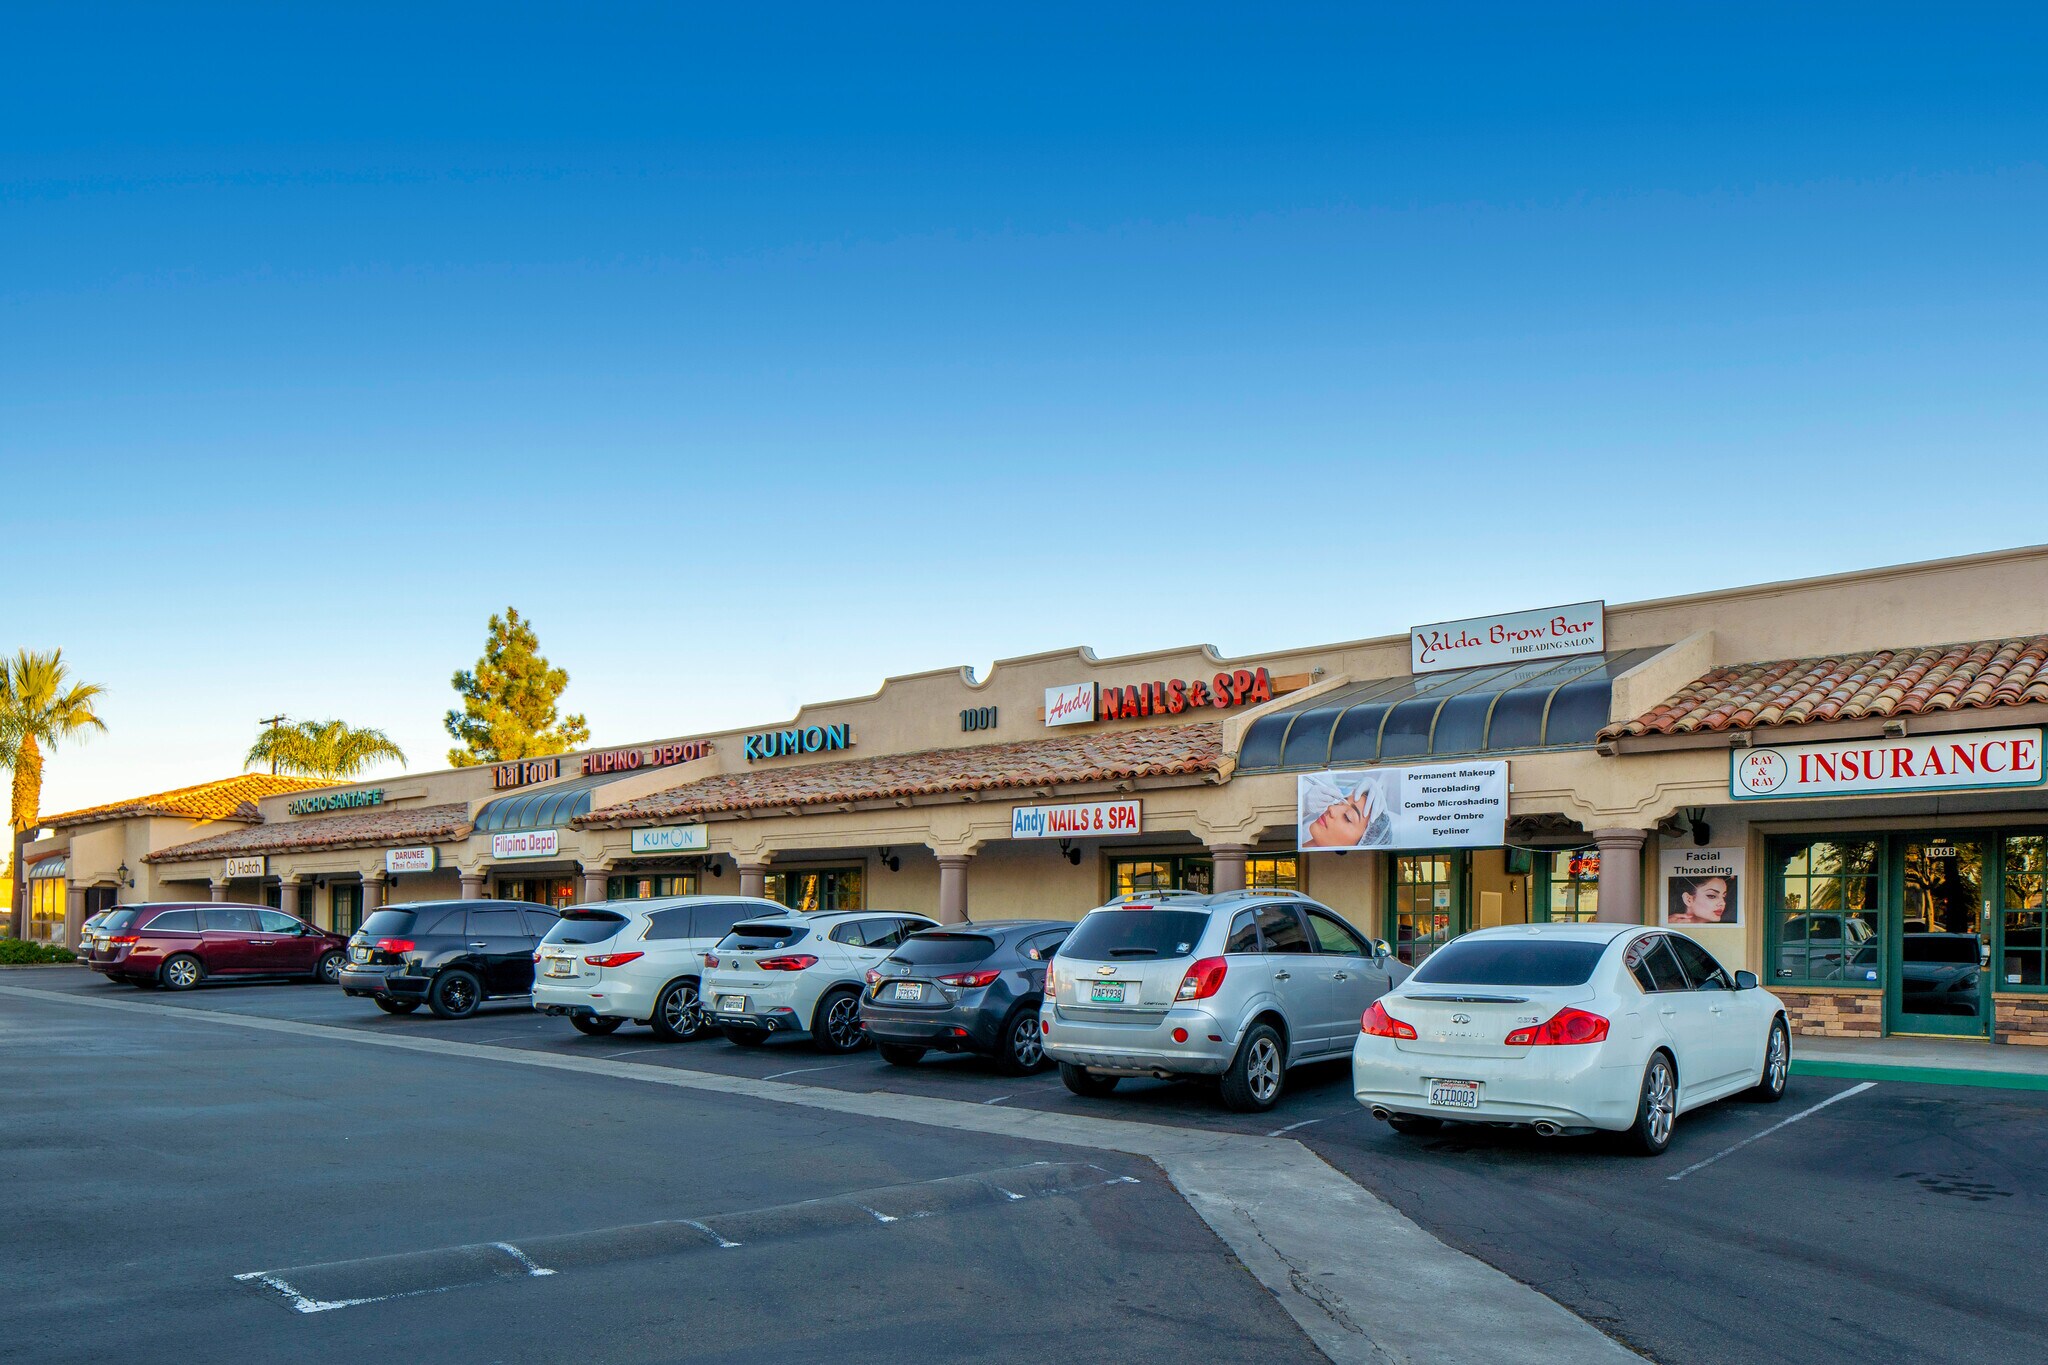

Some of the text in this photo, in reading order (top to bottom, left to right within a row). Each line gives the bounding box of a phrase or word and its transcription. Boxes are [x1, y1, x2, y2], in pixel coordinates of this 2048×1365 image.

[1417, 616, 1595, 664] Yalda Brow Bar
[1510, 637, 1595, 655] THREADING SALON
[1103, 667, 1273, 721] NAILS & SPA
[1048, 686, 1092, 724] Andy
[959, 705, 997, 732] 1001
[744, 723, 849, 760] KUMON
[581, 740, 710, 775] FILIPINO DEPOT
[1750, 755, 1775, 766] RAY
[1797, 739, 2036, 784] INSURANCE
[491, 758, 560, 787] Thai Food
[1408, 769, 1495, 781] Permanent Makeup
[1758, 767, 1768, 776] &
[1421, 784, 1480, 794] Microblading
[1751, 776, 1776, 787] RAY
[288, 788, 384, 816] RANCHO SANTA FE
[1404, 797, 1499, 809] Combo Microshading
[1014, 806, 1137, 836] Andy NAILS & SPA
[1418, 812, 1484, 822] Powder Ombre
[643, 828, 693, 848] KUMON
[1432, 827, 1469, 836] Eyeliner
[495, 832, 556, 856] Filipino Depot
[395, 850, 425, 860] DARUNEE
[1686, 851, 1721, 862] Facial
[237, 860, 261, 875] Hatch
[392, 859, 428, 870] Thai Cuisine
[1569, 859, 1600, 873] OPE
[1674, 864, 1733, 876] Threading
[1432, 1089, 1475, 1104] 6TID003
